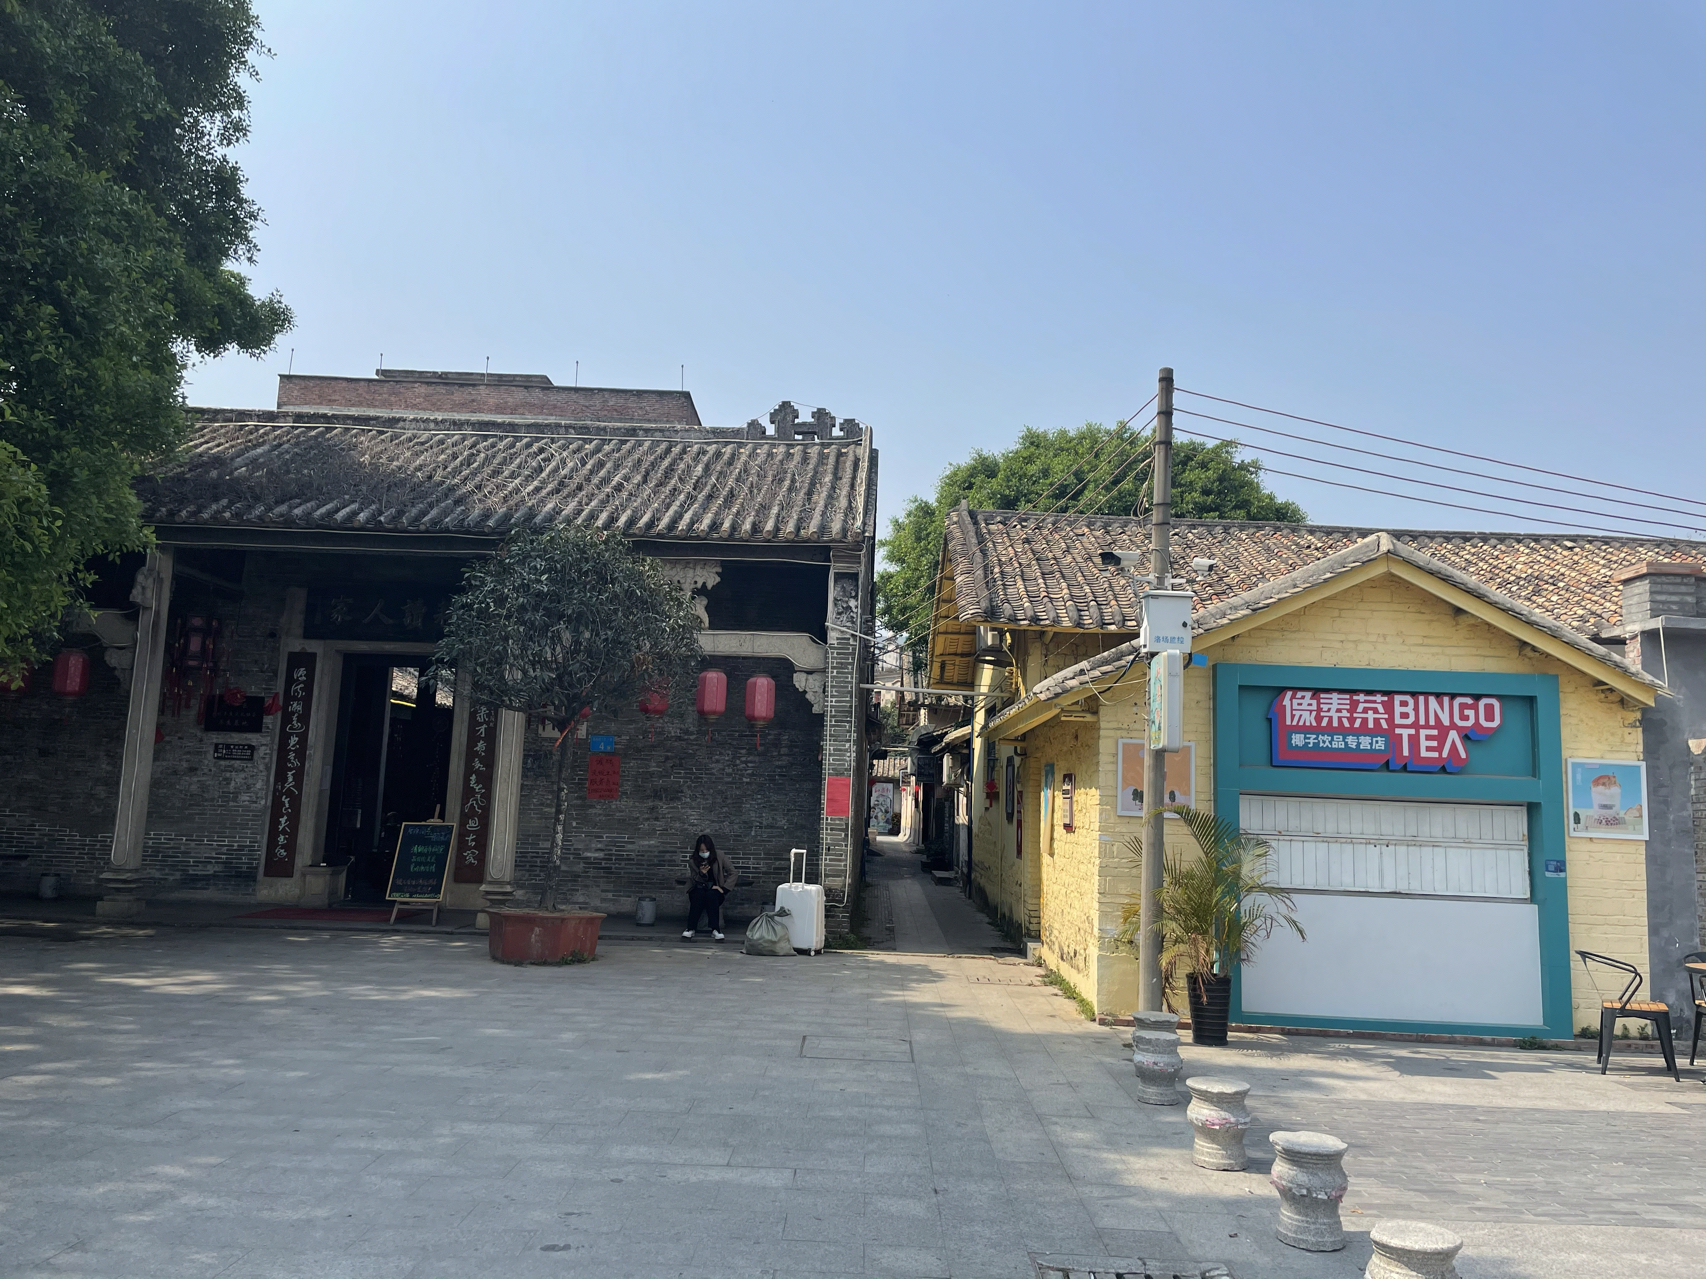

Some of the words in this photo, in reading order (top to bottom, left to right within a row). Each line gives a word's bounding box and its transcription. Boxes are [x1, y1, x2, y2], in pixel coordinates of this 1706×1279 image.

[1154, 635, 1185, 645] 洛场监控
[1282, 690, 1389, 729] 像素茶
[1394, 694, 1501, 728] BINGO
[599, 742, 605, 750] 4
[1291, 733, 1386, 751] 椰子饮品专营店
[1394, 728, 1467, 759] TEA
